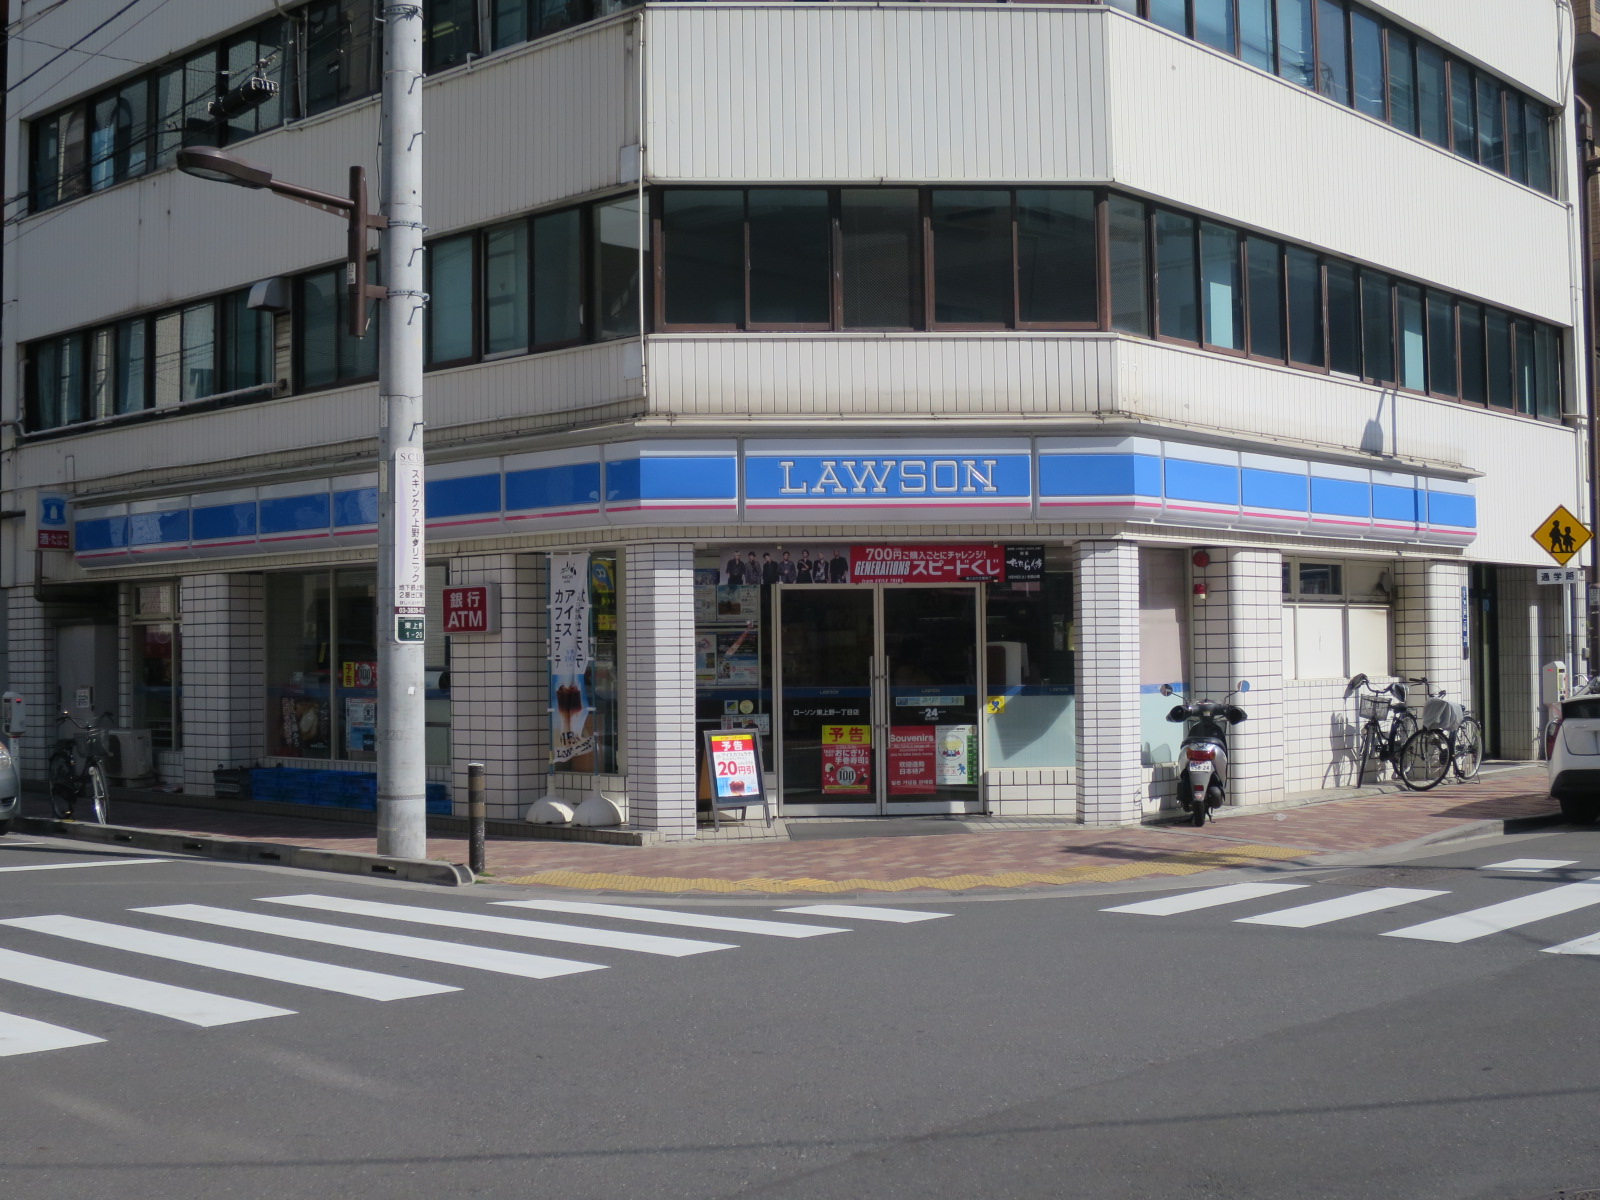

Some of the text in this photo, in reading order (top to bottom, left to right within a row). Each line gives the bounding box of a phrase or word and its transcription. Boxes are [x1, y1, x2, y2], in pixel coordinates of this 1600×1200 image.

[779, 460, 998, 494] LAWSON
[855, 559, 1000, 576] GENERATIONS スピードくじ
[1541, 572, 1574, 581] 通学路
[450, 592, 480, 608] 銀行
[448, 611, 483, 628] ATM
[563, 589, 575, 636] アイス
[555, 589, 563, 668] カフェラテ
[360, 669, 371, 680] 100
[925, 708, 938, 717] 24
[829, 727, 864, 742] 予告
[890, 734, 934, 743] Souvenirs
[721, 741, 743, 751] 予告
[718, 761, 754, 776] 20円引
[839, 771, 854, 781] 100
